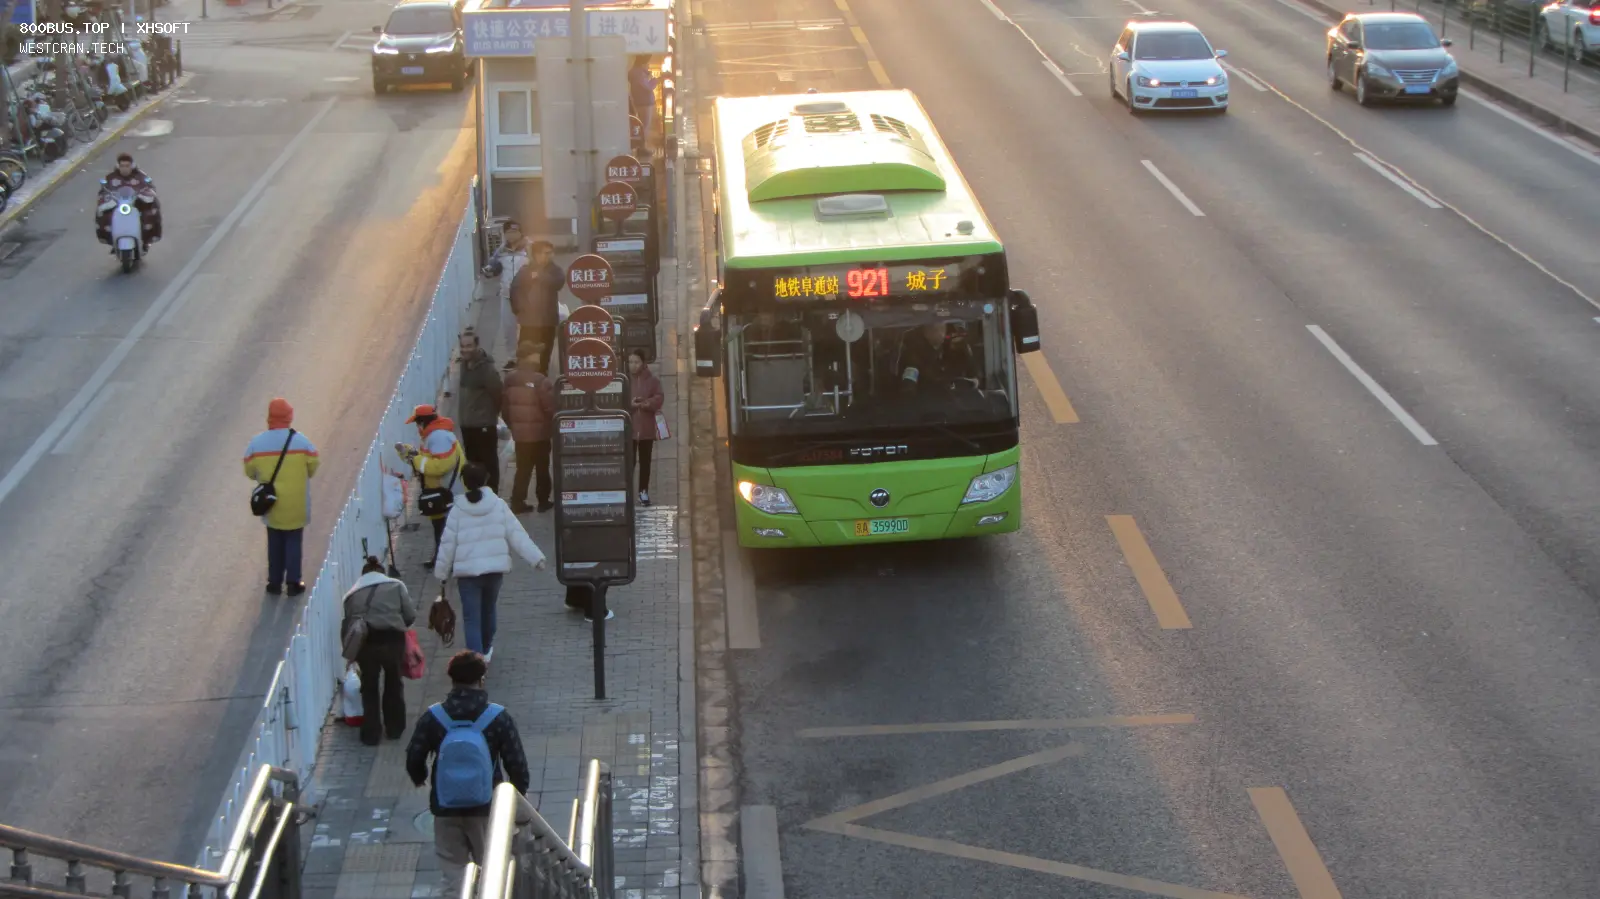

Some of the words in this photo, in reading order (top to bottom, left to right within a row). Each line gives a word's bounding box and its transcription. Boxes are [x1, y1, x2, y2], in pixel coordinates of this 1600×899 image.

[775, 275, 839, 298] 地铁阜通站
[847, 268, 889, 297] 921
[906, 268, 947, 291] 城子
[568, 321, 611, 335] 侯庄子
[568, 355, 613, 370] 侯庄子
[850, 445, 908, 456] FOTON
